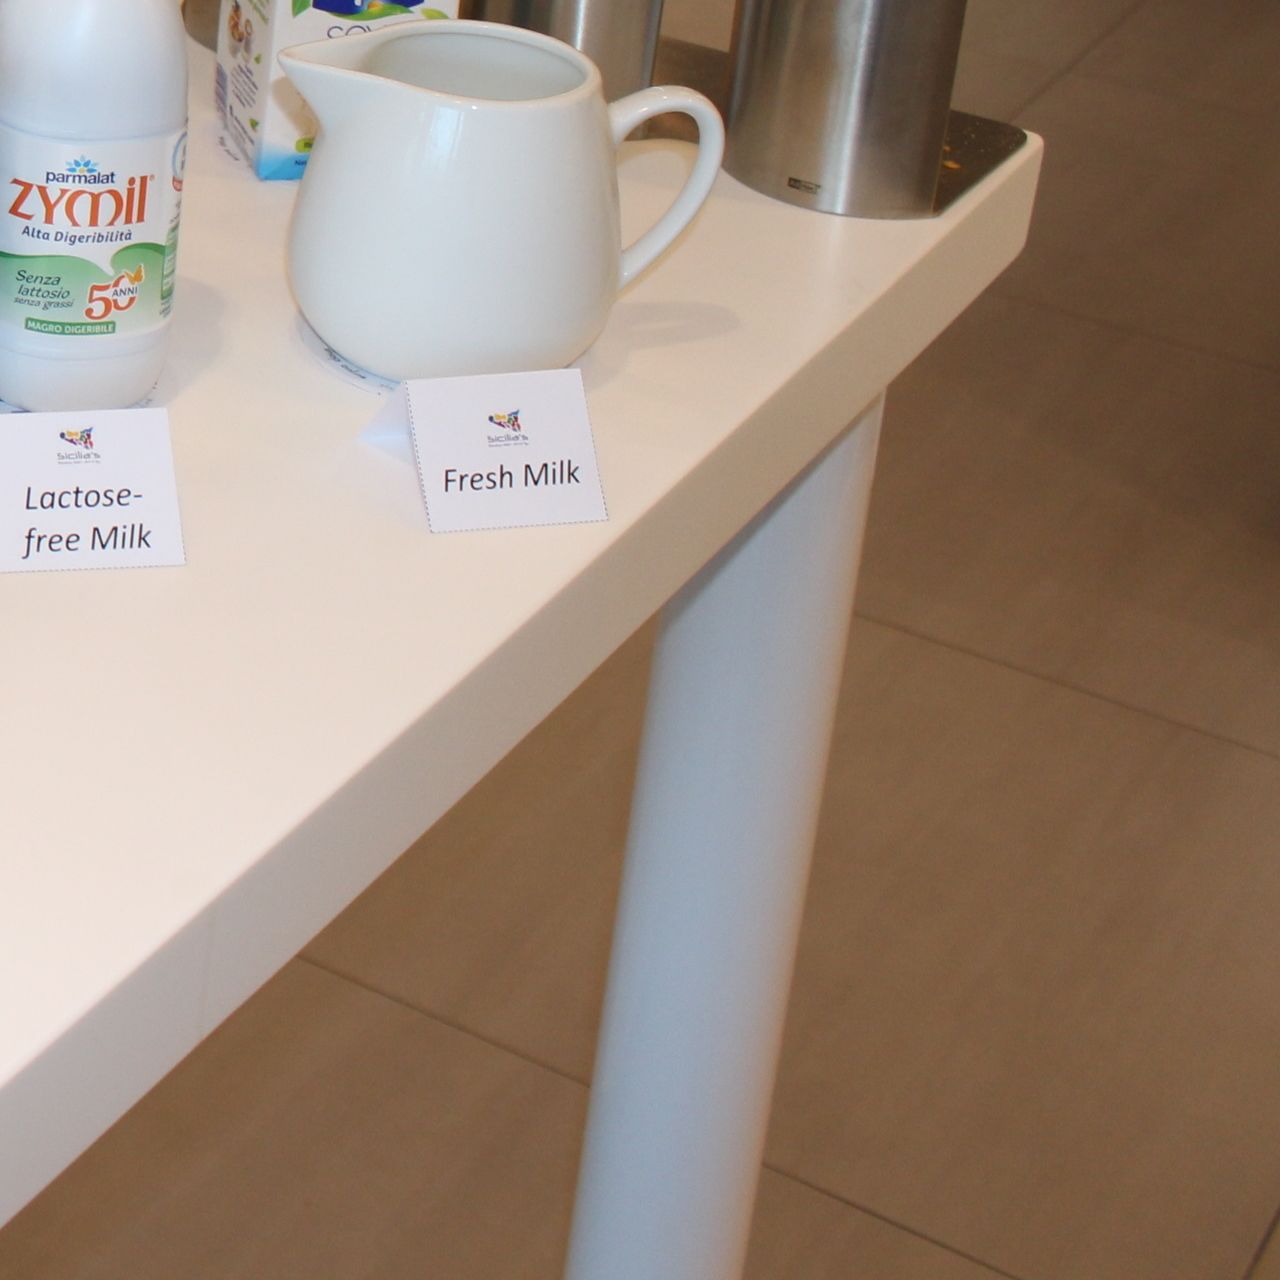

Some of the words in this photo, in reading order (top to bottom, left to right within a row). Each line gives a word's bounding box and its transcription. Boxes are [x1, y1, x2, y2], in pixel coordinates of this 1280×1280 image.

[45, 171, 116, 185] parmalat
[22, 225, 50, 241] Alta
[54, 229, 132, 246] Digeribilità
[16, 270, 62, 286] Senza
[17, 284, 70, 299] lattosio
[111, 286, 138, 298] ANNI
[13, 297, 41, 307] senza
[42, 298, 75, 311] grassi
[27, 319, 62, 333] MAGRO
[64, 322, 114, 334] DIGERIBILE
[444, 464, 513, 493] Fresh
[524, 459, 581, 487] Milk
[25, 486, 143, 510] Lactose-
[22, 527, 80, 559] free
[91, 523, 152, 550] Milk
